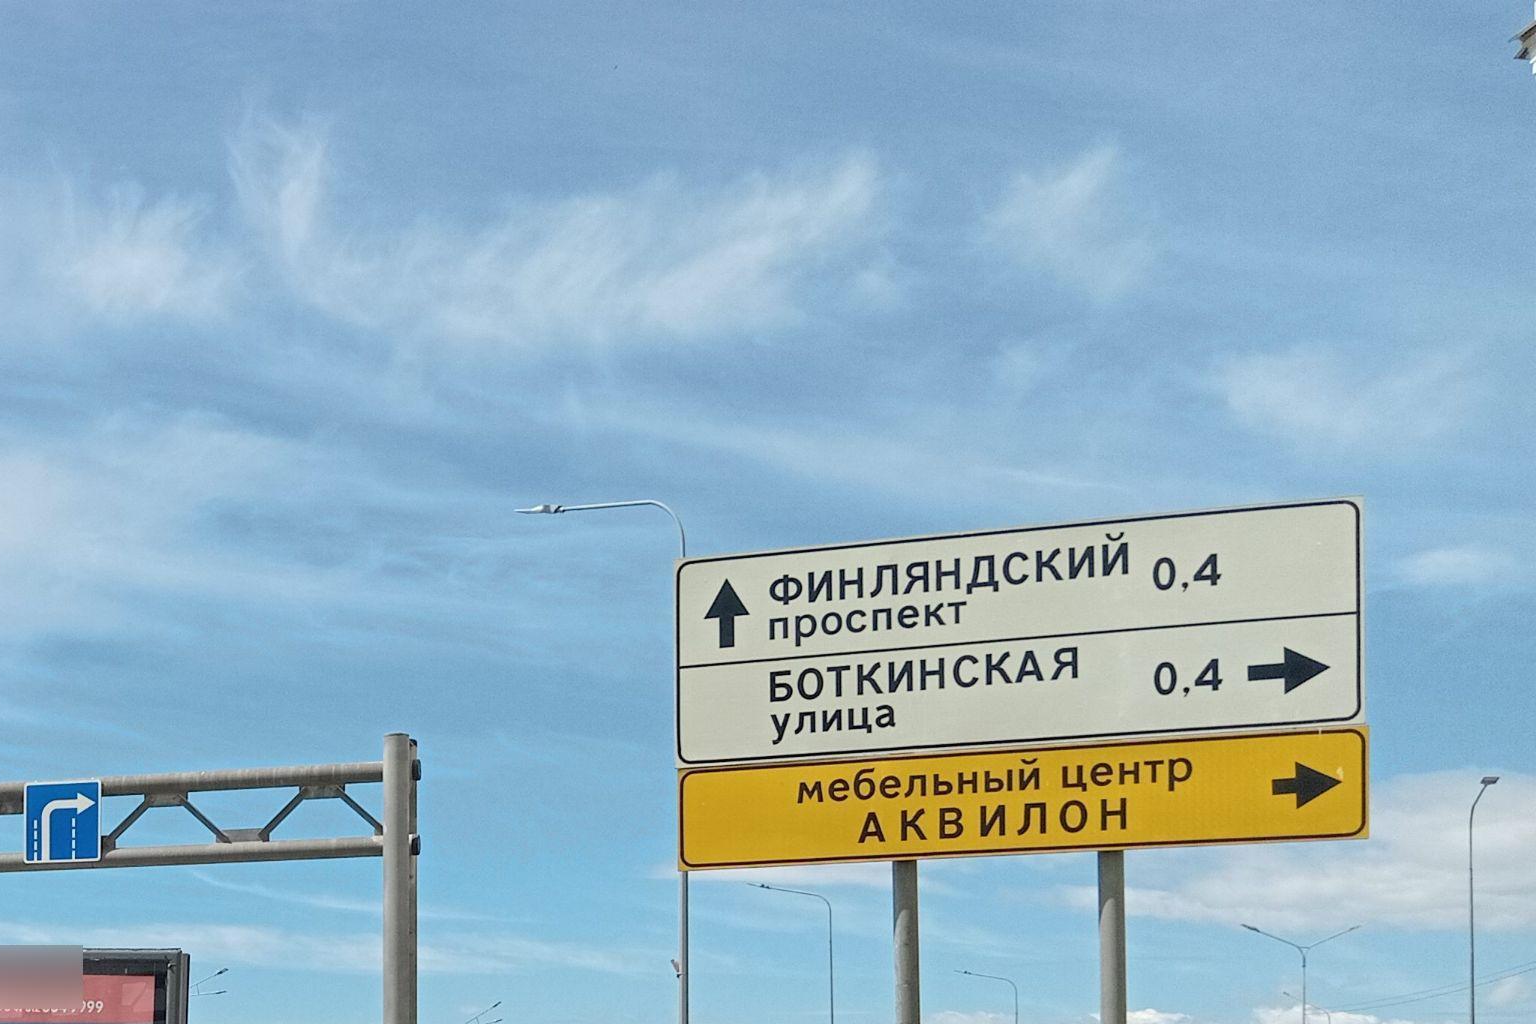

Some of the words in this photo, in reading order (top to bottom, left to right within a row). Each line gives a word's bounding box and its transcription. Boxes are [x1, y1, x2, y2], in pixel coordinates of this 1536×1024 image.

[768, 531, 1130, 605] ФИНЛЯНДСКИЙ
[1152, 553, 1222, 592] 0,4
[768, 600, 967, 647] проспект
[769, 646, 1079, 702] БОТКИНСКАЯ
[1154, 658, 1223, 697] 0,4
[770, 704, 896, 745] улица
[797, 758, 1041, 804] мебельный
[1061, 757, 1193, 792] центр
[858, 797, 1128, 844] АКВИЛОН
